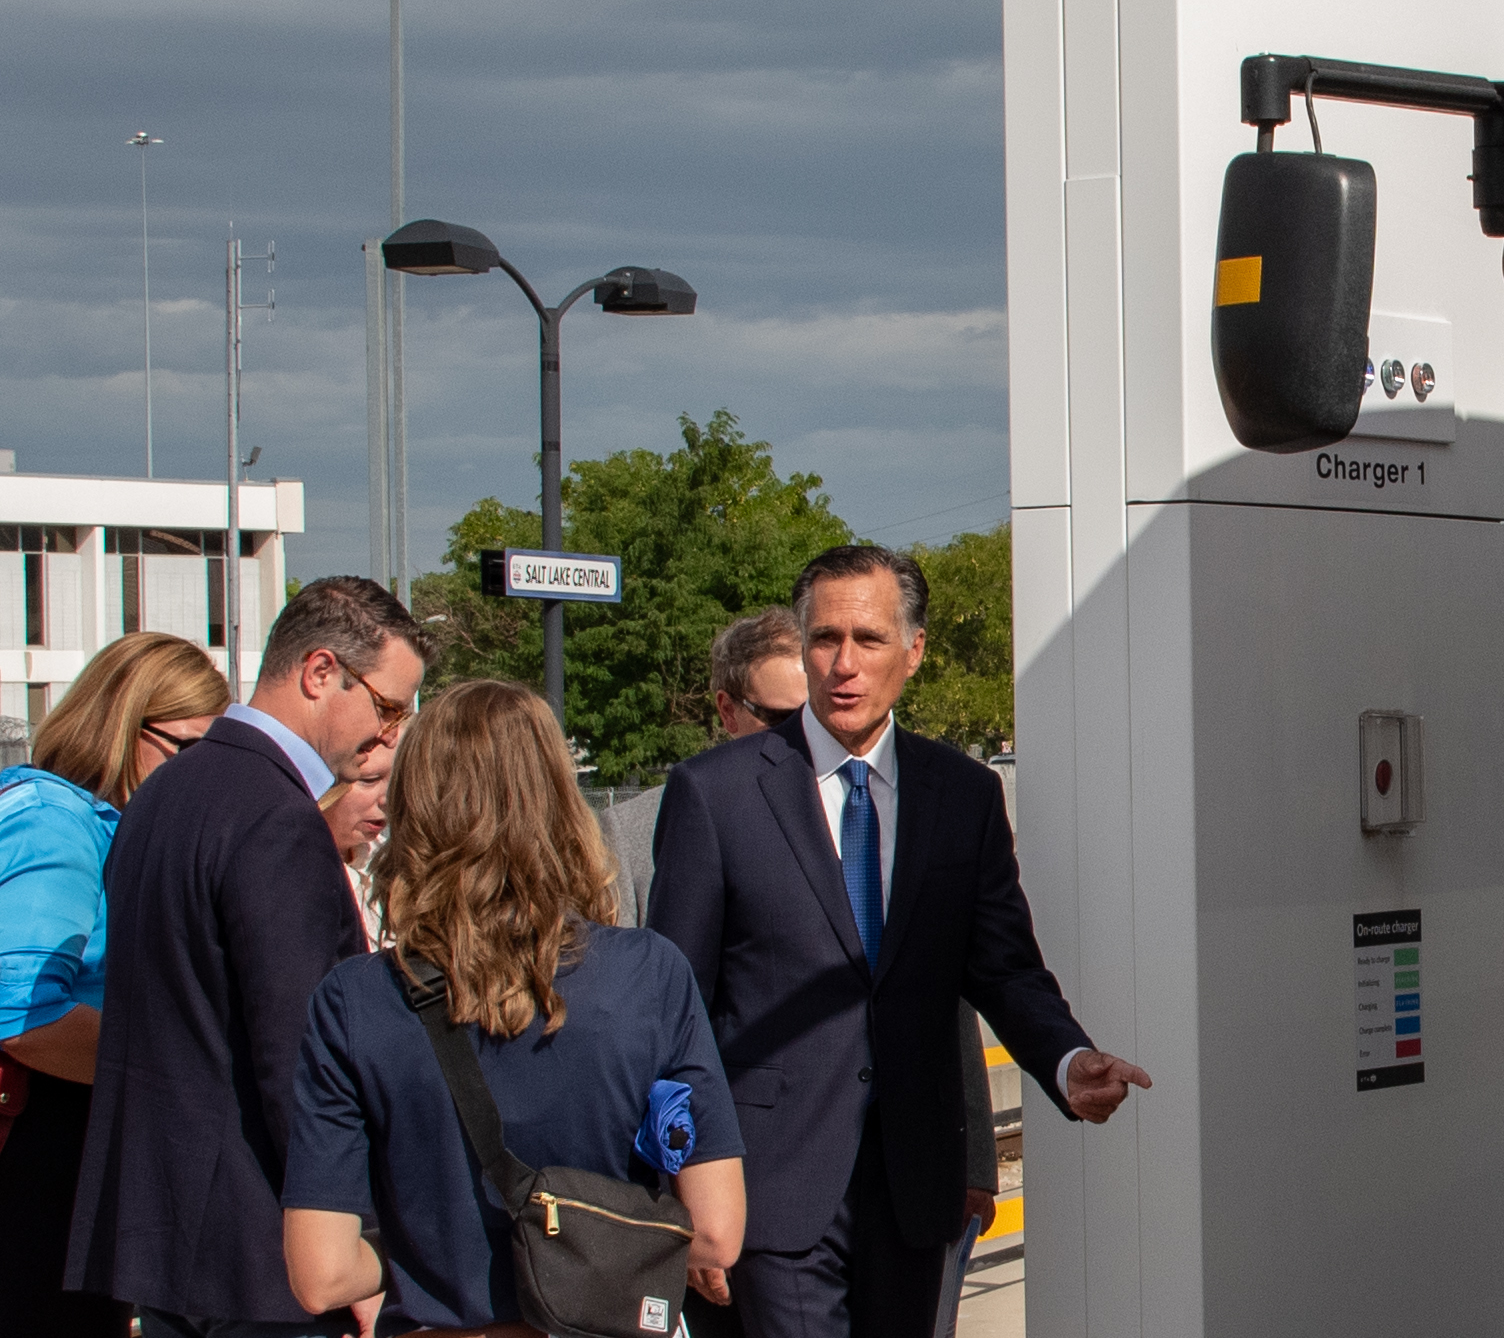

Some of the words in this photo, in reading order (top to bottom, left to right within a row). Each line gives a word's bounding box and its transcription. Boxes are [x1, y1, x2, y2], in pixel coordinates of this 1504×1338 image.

[1315, 452, 1409, 489] Charger
[1416, 462, 1426, 486] 1
[525, 564, 547, 585] SALT
[548, 566, 571, 586] LAKE
[573, 568, 610, 589] CENTRAL
[1356, 922, 1391, 937] On-route
[1391, 919, 1419, 935] charger
